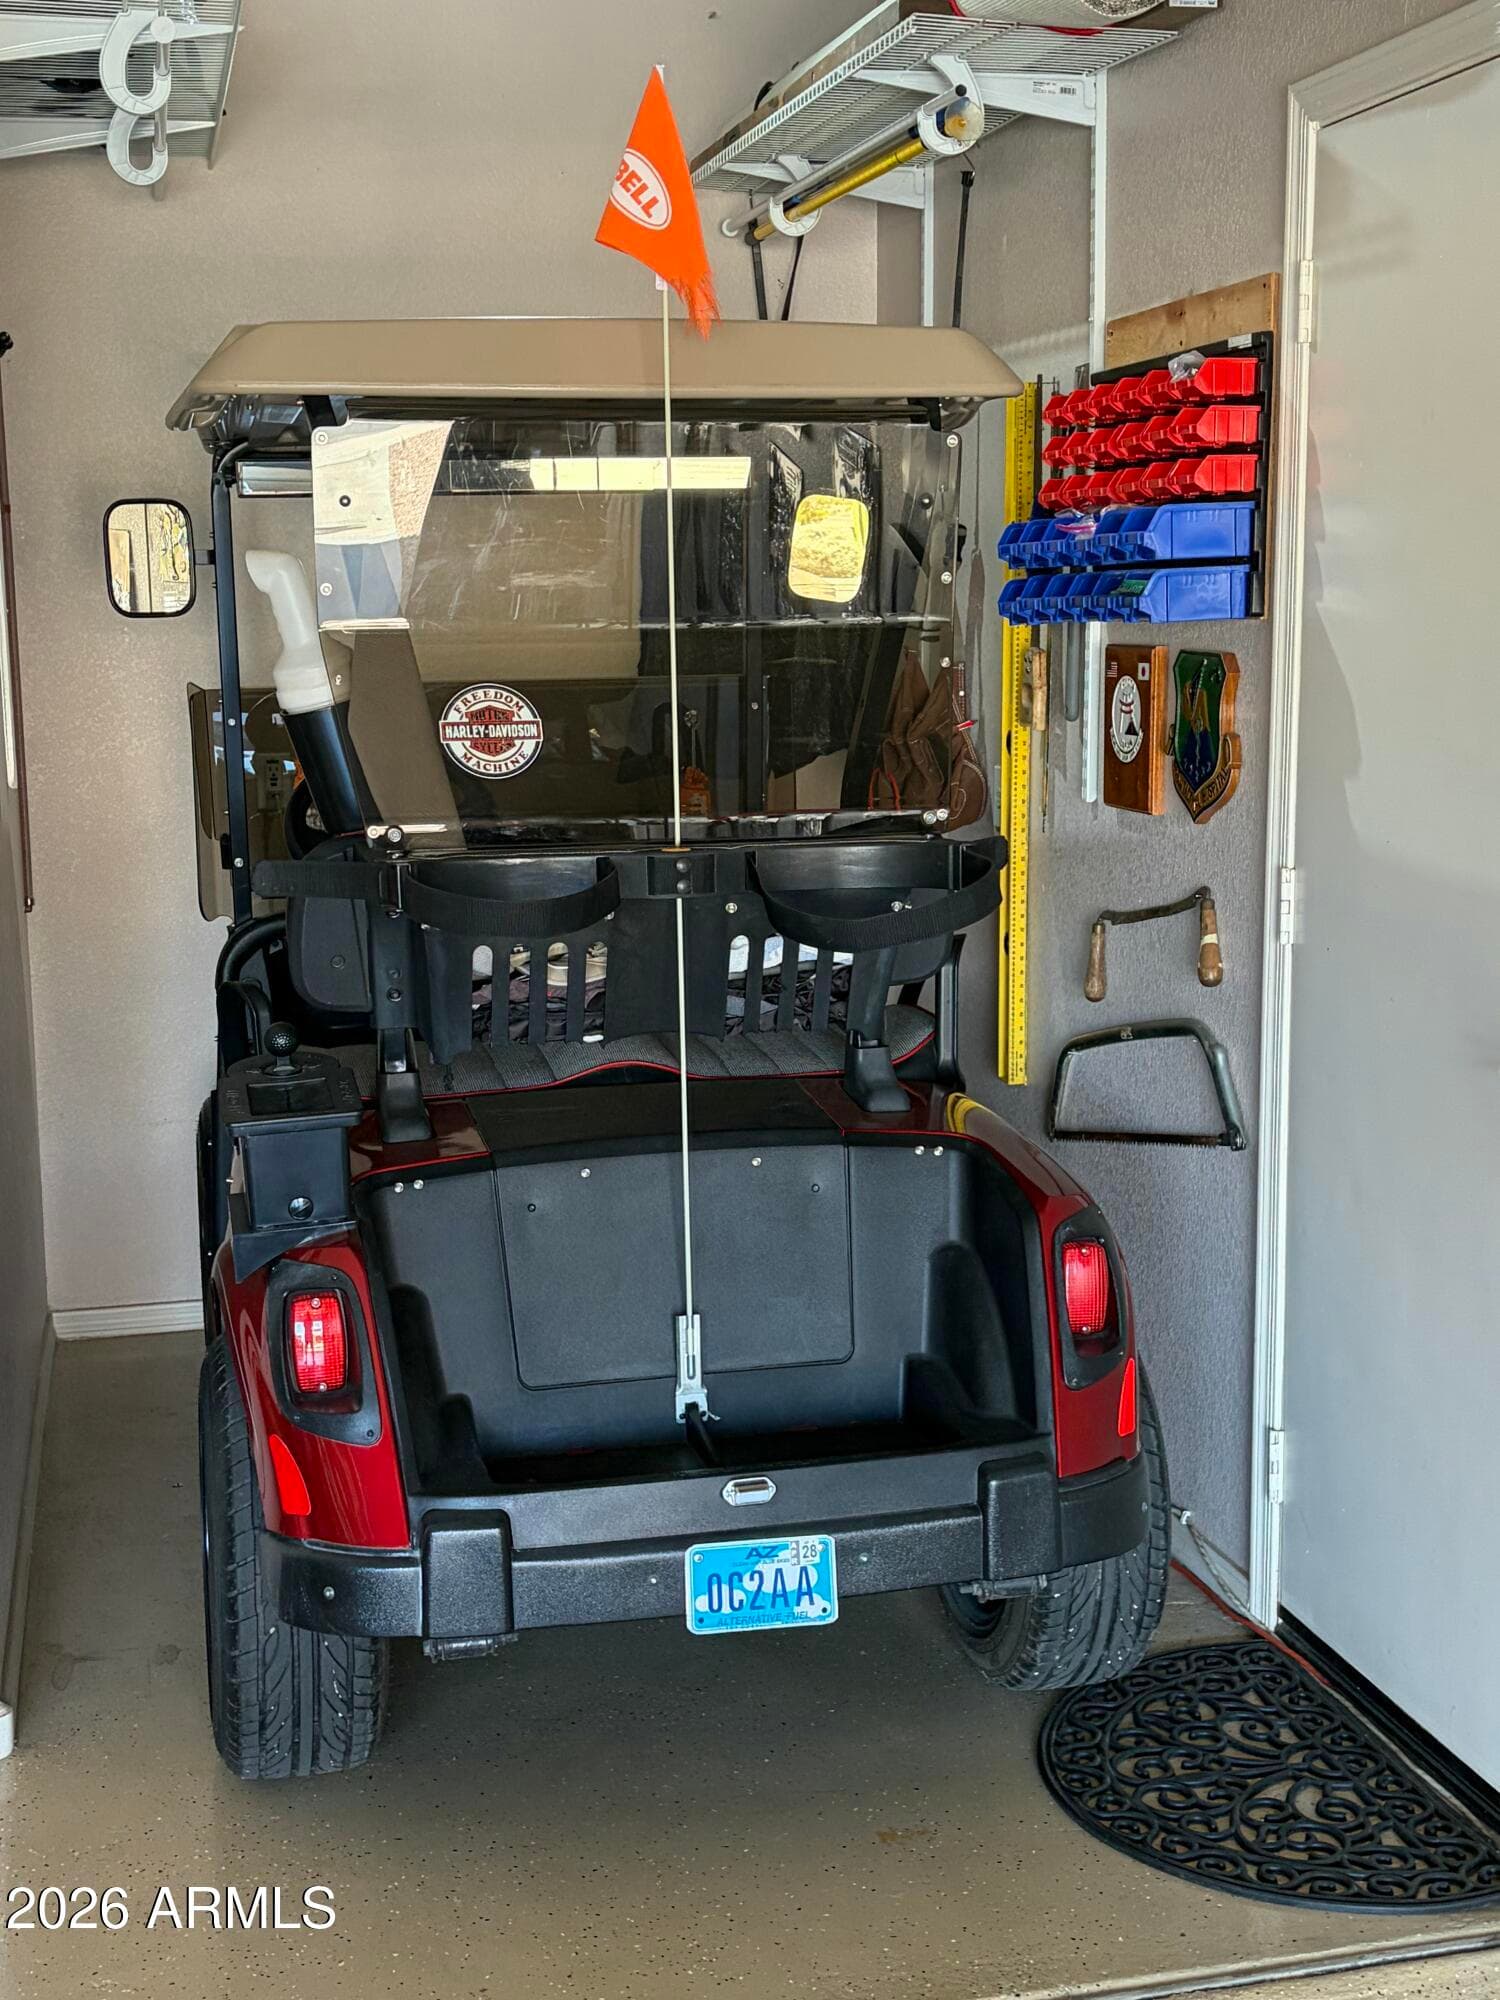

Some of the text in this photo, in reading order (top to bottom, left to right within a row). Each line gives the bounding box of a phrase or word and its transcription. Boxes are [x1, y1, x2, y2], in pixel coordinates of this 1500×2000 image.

[615, 159, 659, 218] BELL
[453, 690, 525, 715] FREEDOM
[445, 723, 538, 739] HARLEY-DAVIDSON
[461, 750, 529, 773] MACHINE
[745, 1545, 779, 1560] AZ
[802, 1543, 818, 1559] 28
[717, 1612, 782, 1627] ALTERNATIVE
[784, 1610, 809, 1621] FUEL
